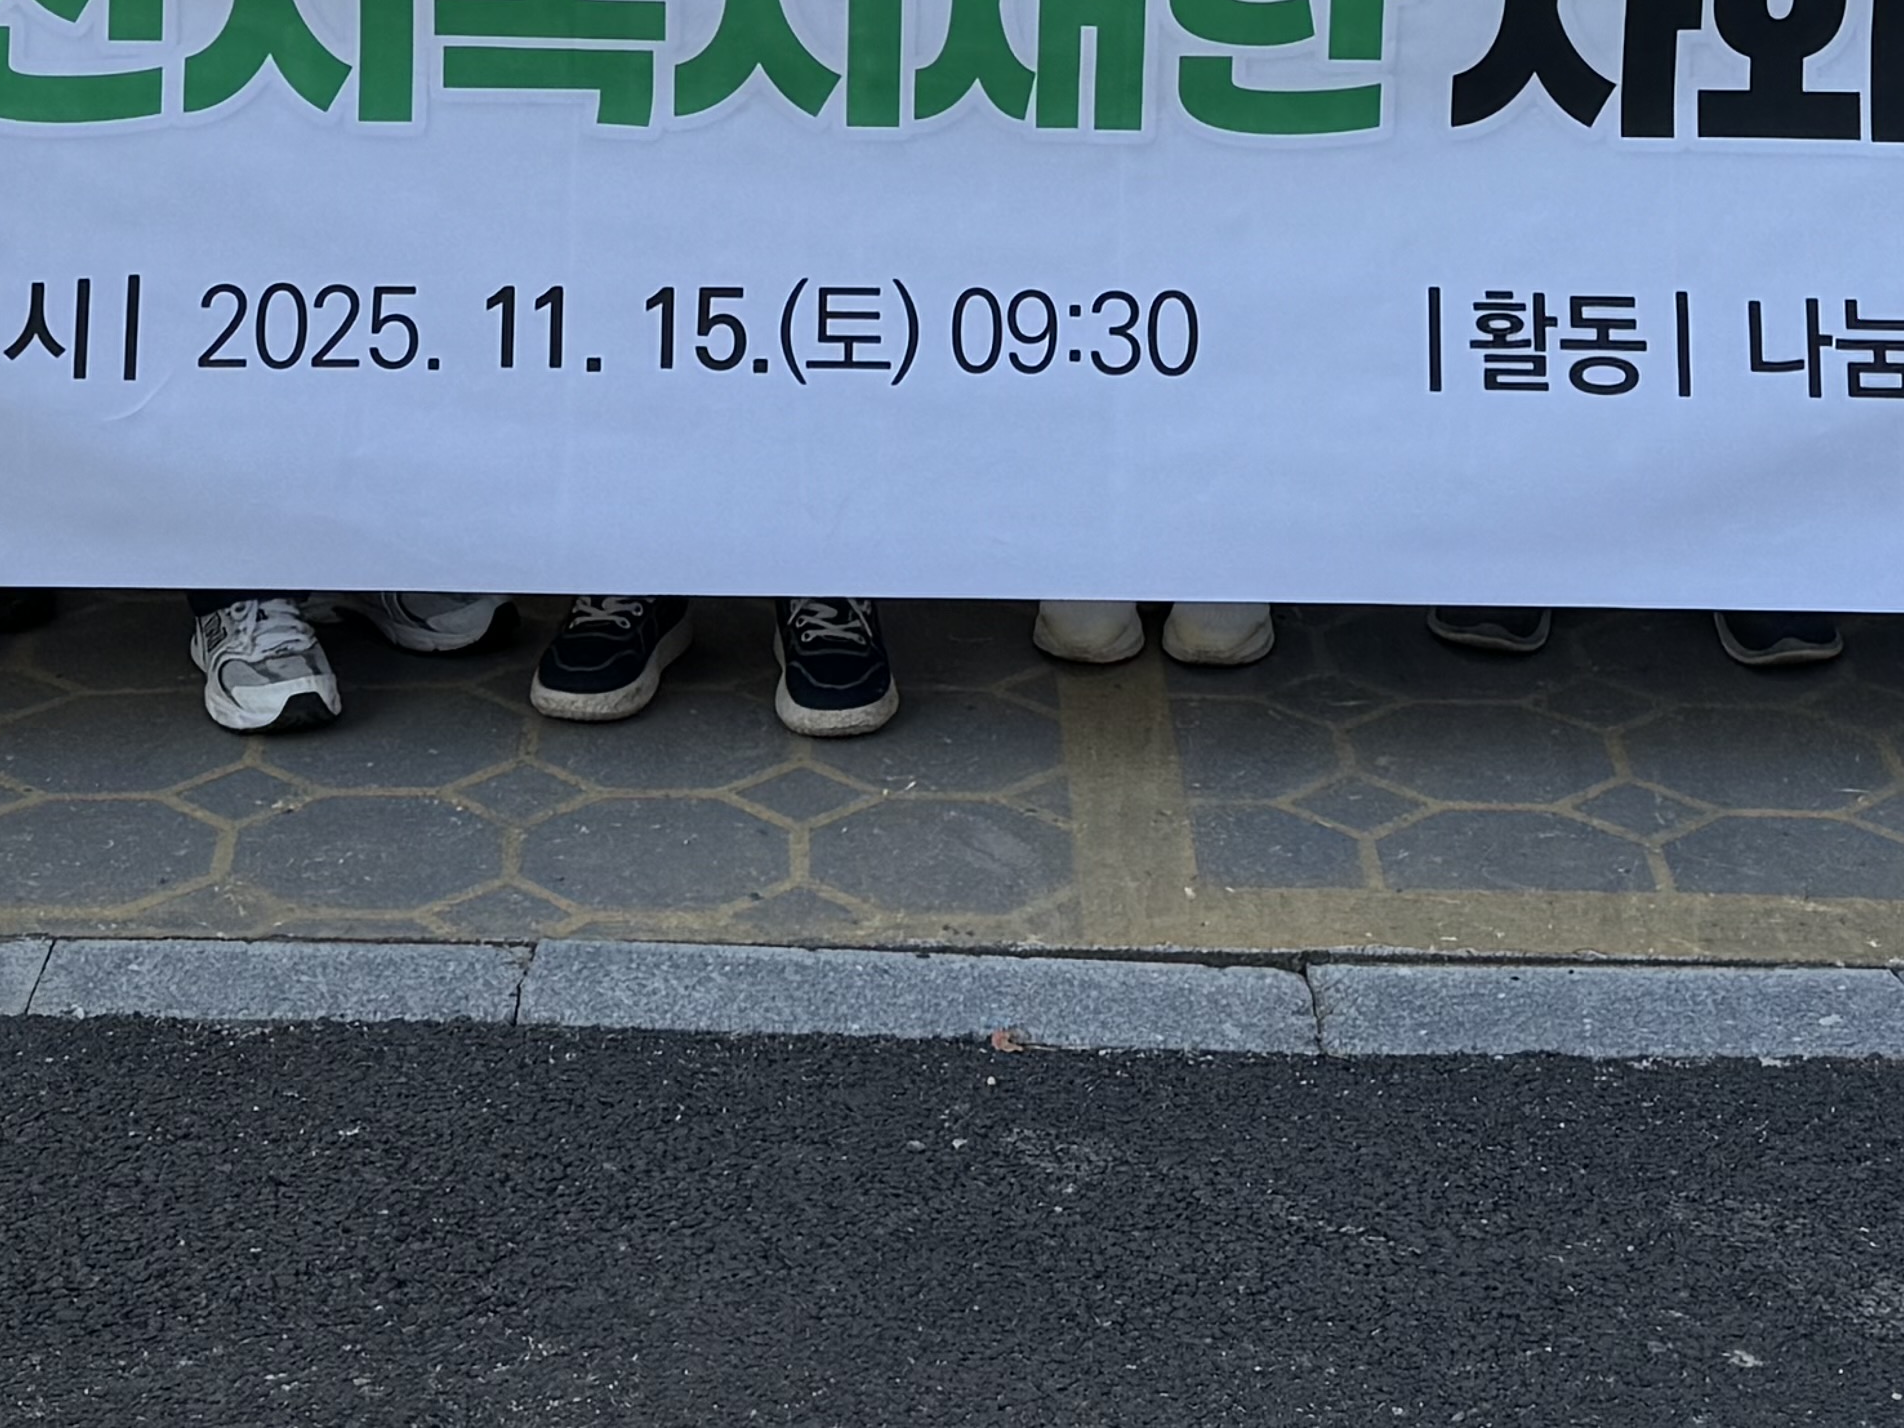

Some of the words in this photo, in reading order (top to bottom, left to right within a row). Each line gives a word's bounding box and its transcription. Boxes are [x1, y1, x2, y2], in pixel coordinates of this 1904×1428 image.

[197, 282, 441, 372] 2025.
[486, 284, 603, 374] 11.
[951, 286, 1199, 378] 09:30
